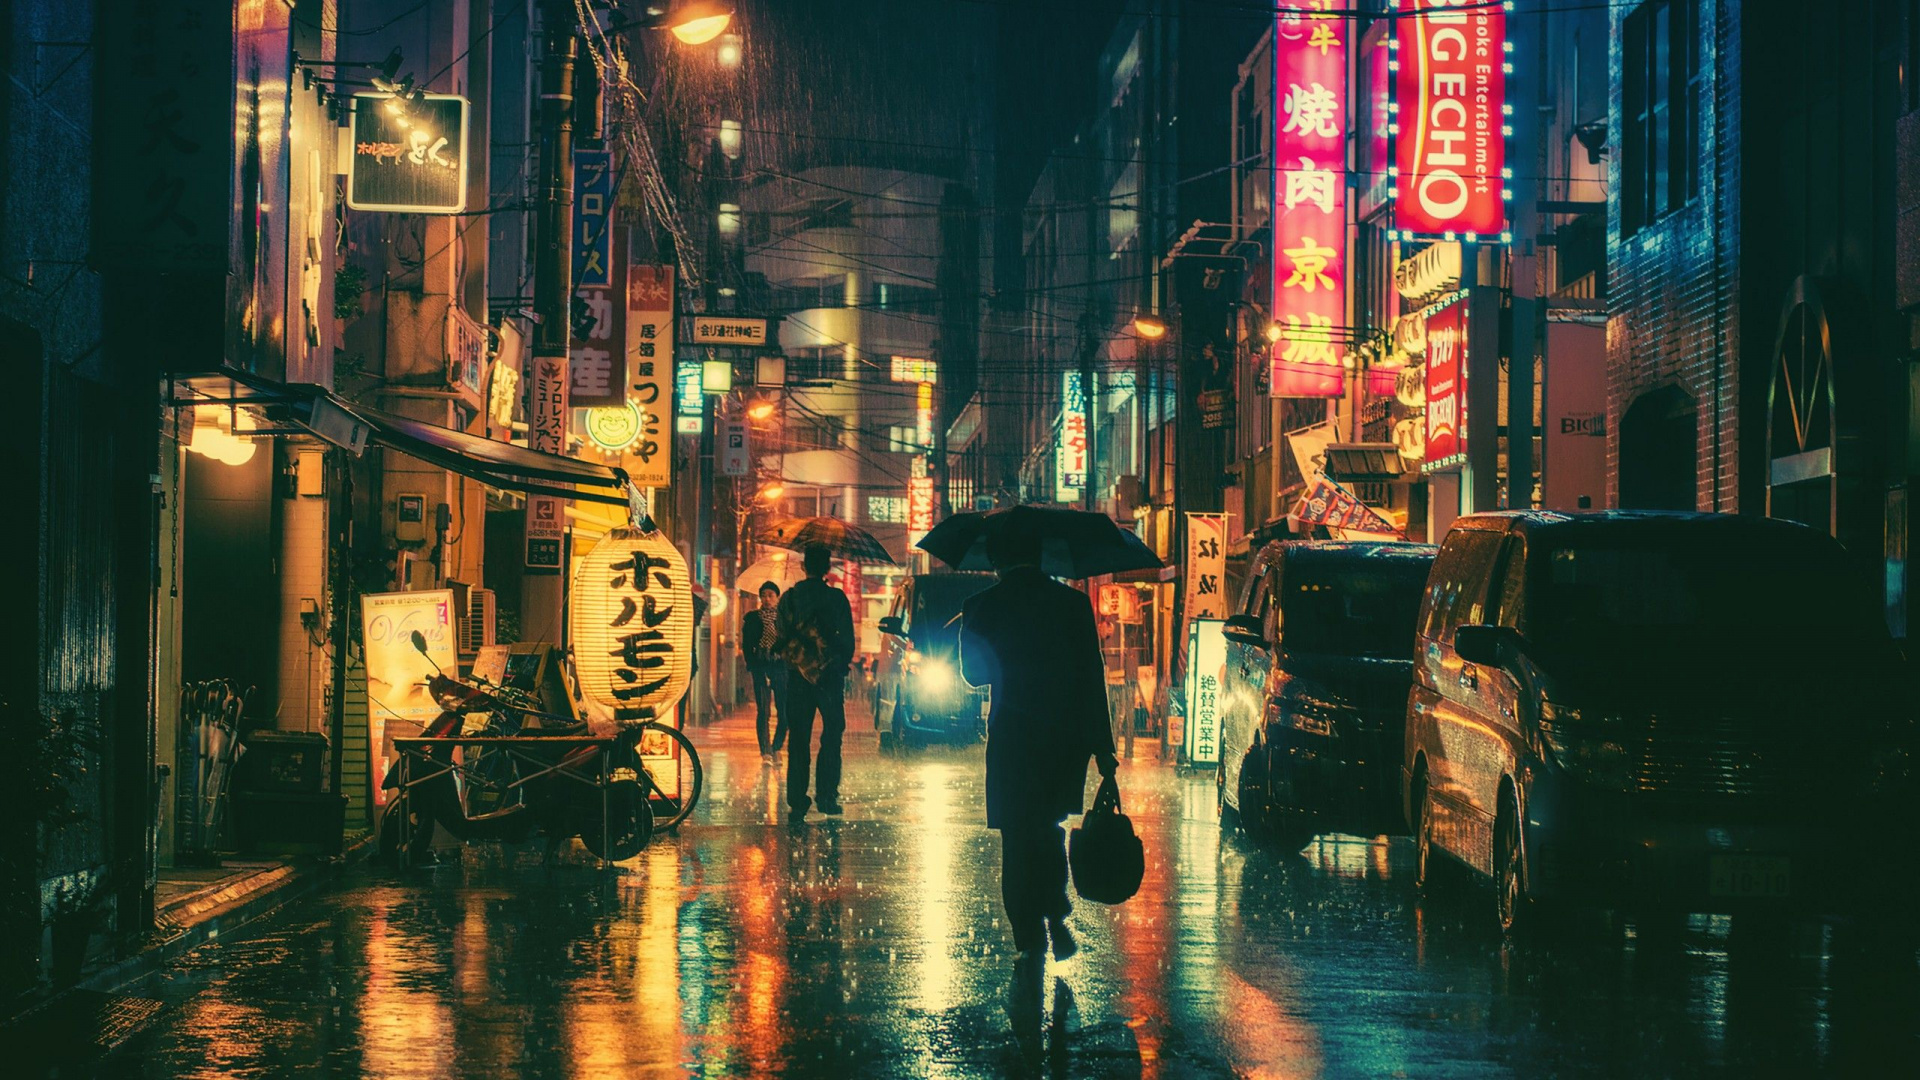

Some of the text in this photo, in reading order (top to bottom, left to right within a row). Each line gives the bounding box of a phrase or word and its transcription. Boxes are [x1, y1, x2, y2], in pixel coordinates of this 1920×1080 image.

[357, 142, 400, 155] ホルモン
[1418, 0, 1468, 220] IG ECHO
[1475, 64, 1492, 194] Entertainment
[582, 160, 608, 276] プロレス
[1282, 83, 1340, 367] 焼肉京城
[731, 436, 741, 447] P
[369, 610, 444, 647] Veus
[609, 551, 674, 700] ホルモン
[1198, 674, 1217, 760] 絶賛営業中
